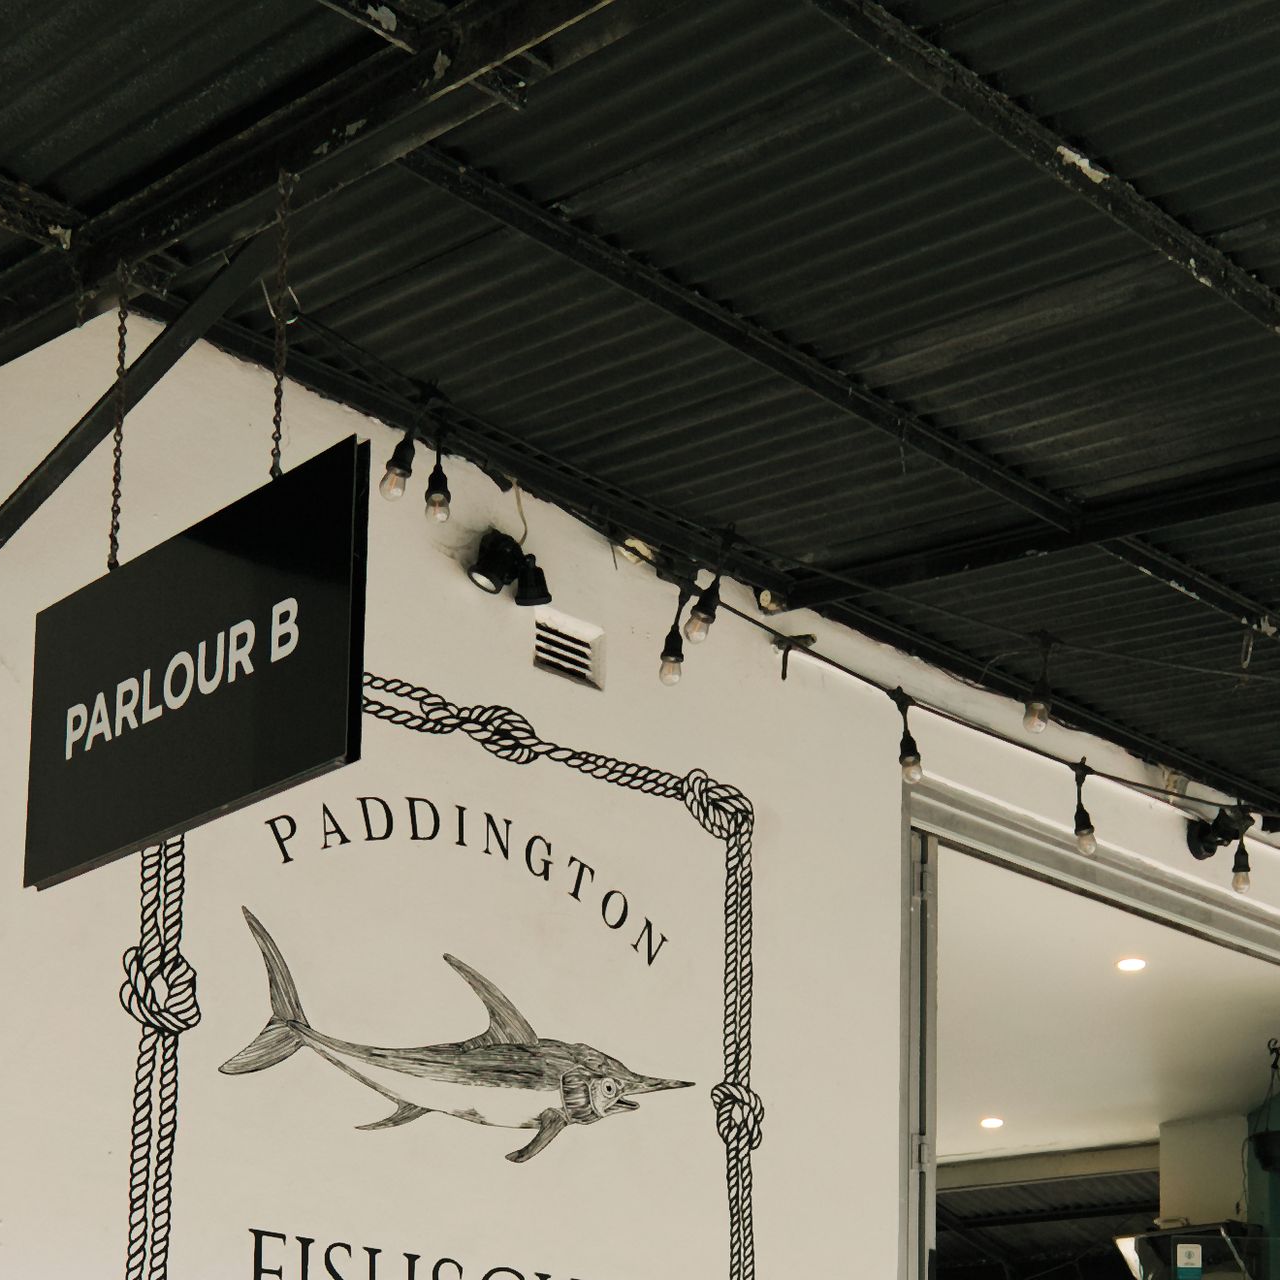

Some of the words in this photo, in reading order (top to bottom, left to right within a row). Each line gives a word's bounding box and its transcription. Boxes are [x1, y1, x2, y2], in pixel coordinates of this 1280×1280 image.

[66, 618, 256, 761] PARLOUR
[270, 597, 300, 663] B
[265, 796, 669, 967] PADDINGTON
